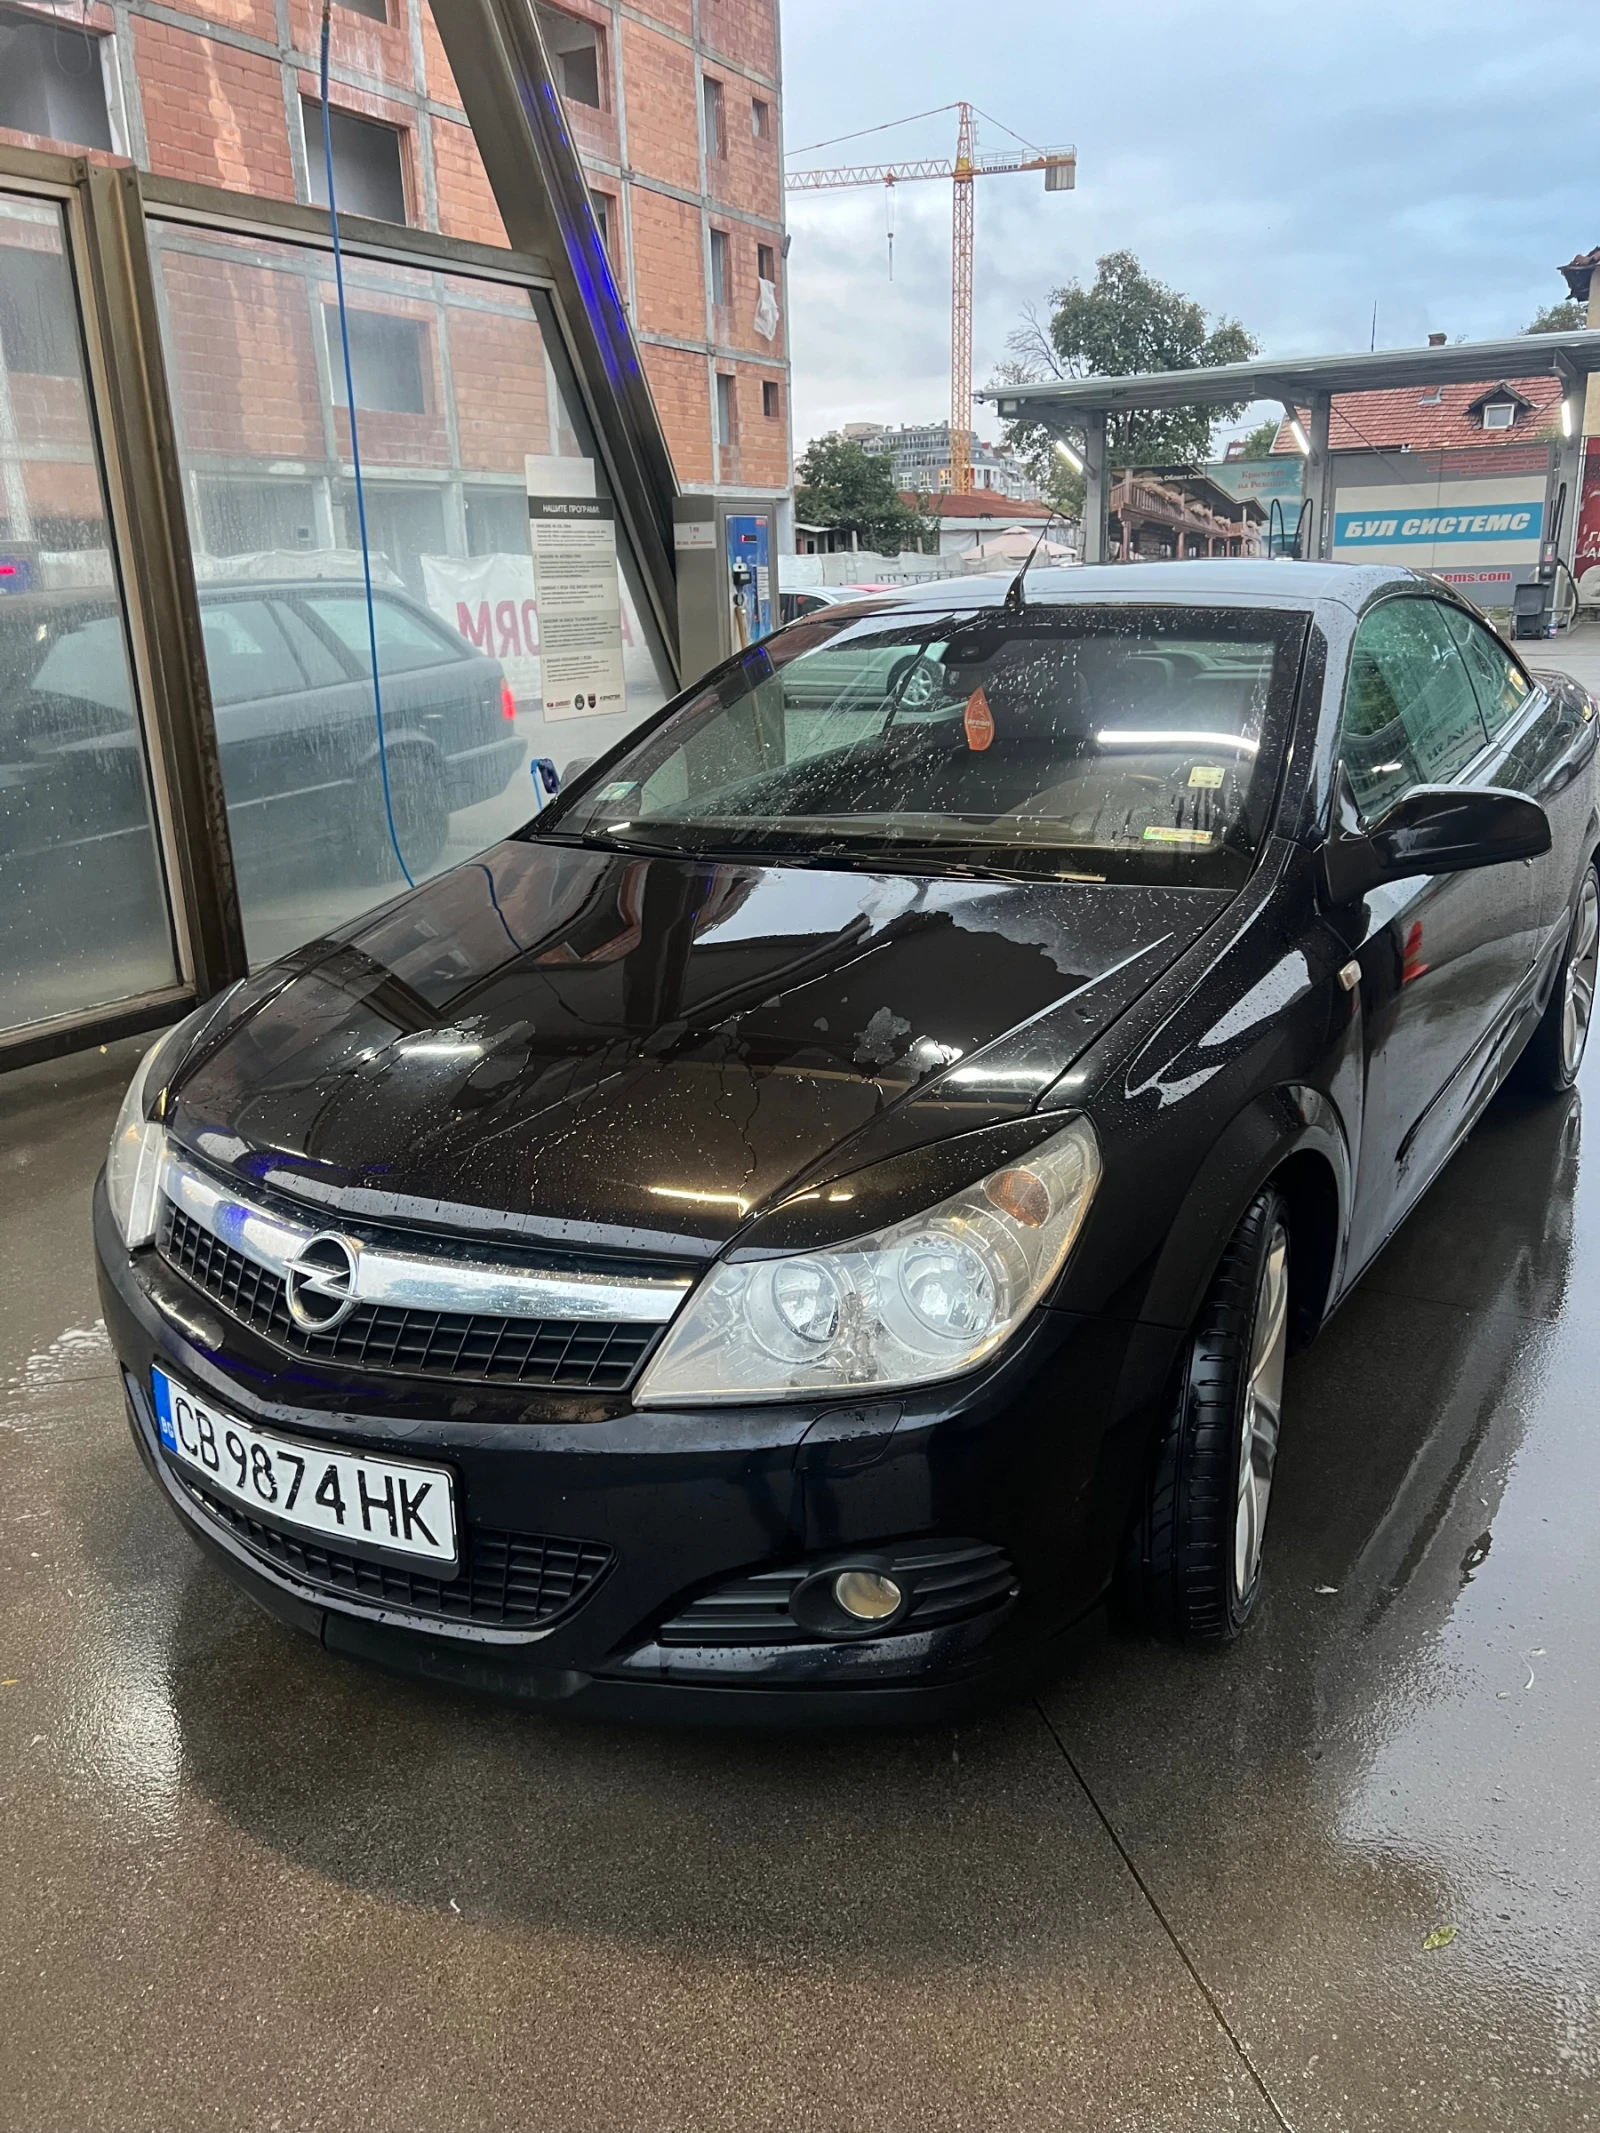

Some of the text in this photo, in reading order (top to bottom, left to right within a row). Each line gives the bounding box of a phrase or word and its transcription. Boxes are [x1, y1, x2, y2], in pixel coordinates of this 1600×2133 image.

[543, 504, 568, 513] НАШИТЕ
[1345, 512, 1531, 538] БУЛ СИСТЕМС
[161, 1417, 175, 1439] BG
